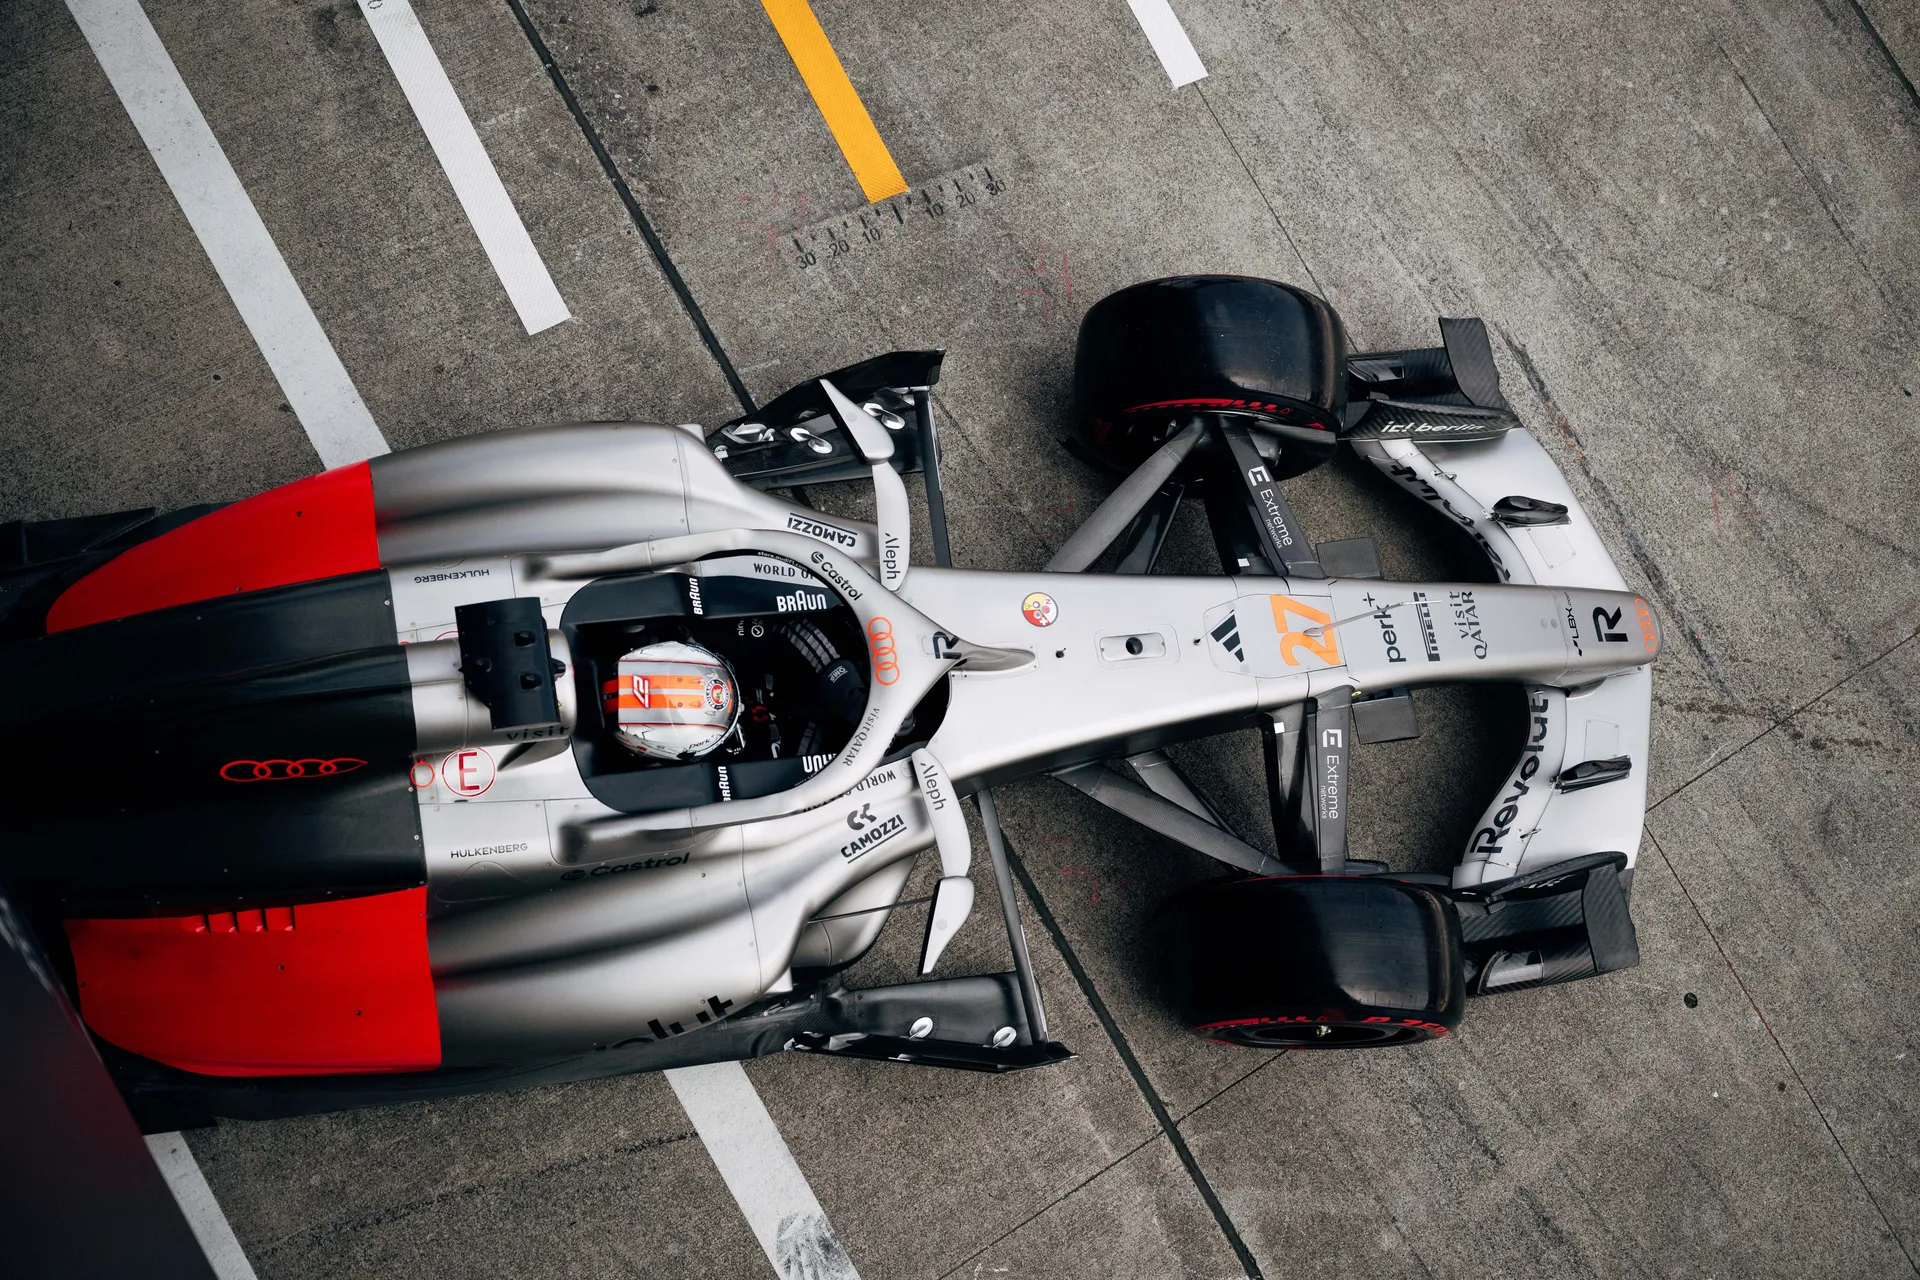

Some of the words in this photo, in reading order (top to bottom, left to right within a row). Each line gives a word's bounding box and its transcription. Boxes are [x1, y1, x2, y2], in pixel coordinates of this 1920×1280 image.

[798, 252, 816, 270] 30
[829, 239, 850, 259] 20
[862, 228, 881, 245] 10
[926, 203, 944, 220] 10
[956, 190, 976, 208] 20
[986, 179, 1006, 197] 30
[1415, 422, 1486, 433] berlin
[787, 517, 856, 548] CAMOZZI
[1260, 488, 1293, 546] Extreme
[1265, 518, 1282, 549] networks
[753, 563, 796, 578] WORLD
[883, 532, 901, 580] Aleph
[414, 569, 490, 584] HULKENBERG
[688, 577, 704, 615] BRAUN
[821, 561, 863, 601] Castrol
[776, 590, 828, 612] BRAUN
[1449, 591, 1470, 639] visit
[1270, 594, 1340, 666] 27
[1461, 591, 1488, 659] QATAR
[506, 726, 570, 741] visit
[459, 752, 480, 791] E
[920, 763, 947, 810] Aleph
[1326, 755, 1340, 819] Extreme
[1470, 698, 1549, 854] Revolut
[1320, 785, 1328, 819] networks
[451, 843, 528, 859] HULKENBERG
[840, 814, 905, 858] CAMOZZI
[589, 852, 691, 878] Castrol
